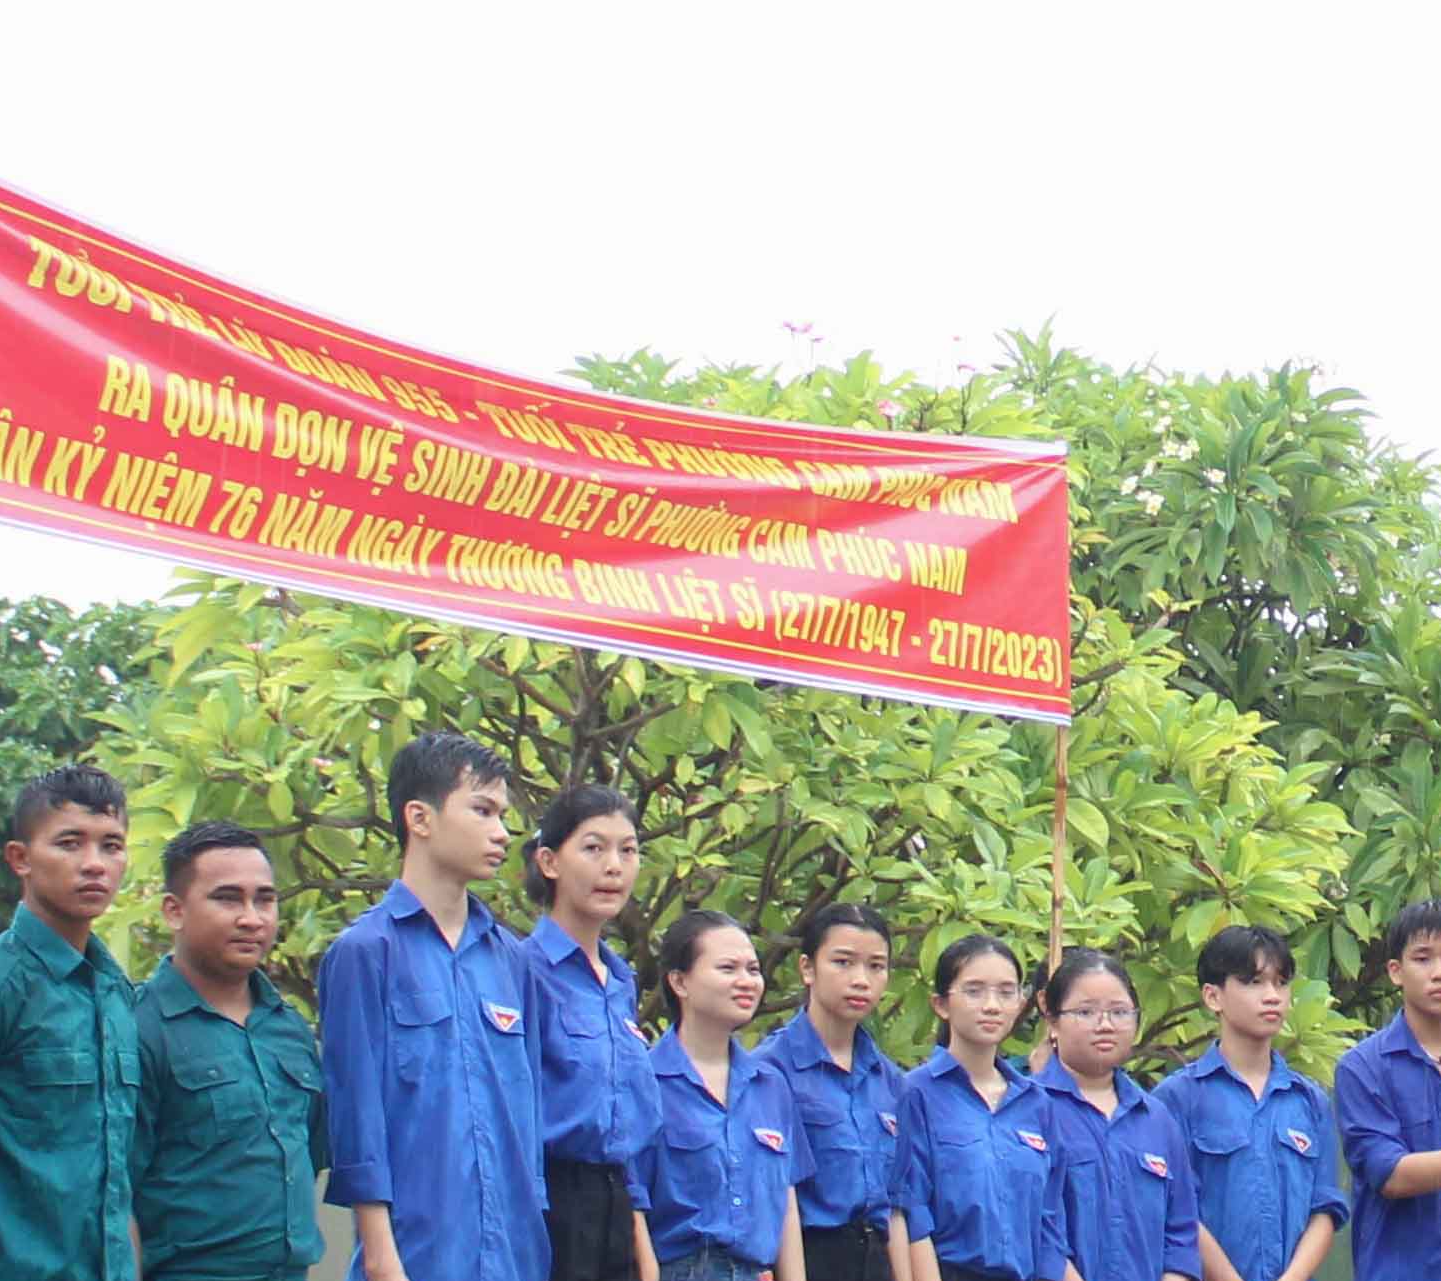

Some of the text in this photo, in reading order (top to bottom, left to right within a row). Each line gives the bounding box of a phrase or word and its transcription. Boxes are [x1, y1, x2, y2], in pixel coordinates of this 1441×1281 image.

[43, 425, 106, 501] KỶ
[102, 450, 212, 529] NIỆM
[209, 481, 263, 540] 76
[258, 488, 353, 559] NĂM
[346, 515, 444, 578] NGÀY
[445, 534, 574, 600] THƯƠNG
[572, 558, 661, 613] BINH
[657, 568, 726, 632] LIỆT
[731, 576, 765, 631] SĨ
[771, 591, 907, 657] (27/7/1947
[928, 618, 1063, 686] 27/7/2023)
[98, 355, 151, 422] RA
[164, 376, 265, 453] QUÂN
[272, 401, 351, 477] DỌN
[356, 420, 404, 495] VỆ
[404, 439, 494, 506] SINH
[485, 457, 551, 519] ĐÀI
[540, 472, 617, 539] LIỆT
[605, 487, 657, 541] SĨ
[748, 519, 815, 569] CAM
[815, 527, 902, 583] PHÚC
[903, 541, 968, 596] NAM
[380, 374, 459, 423] 955
[794, 460, 871, 501] CAM
[939, 477, 1018, 524] NAM
